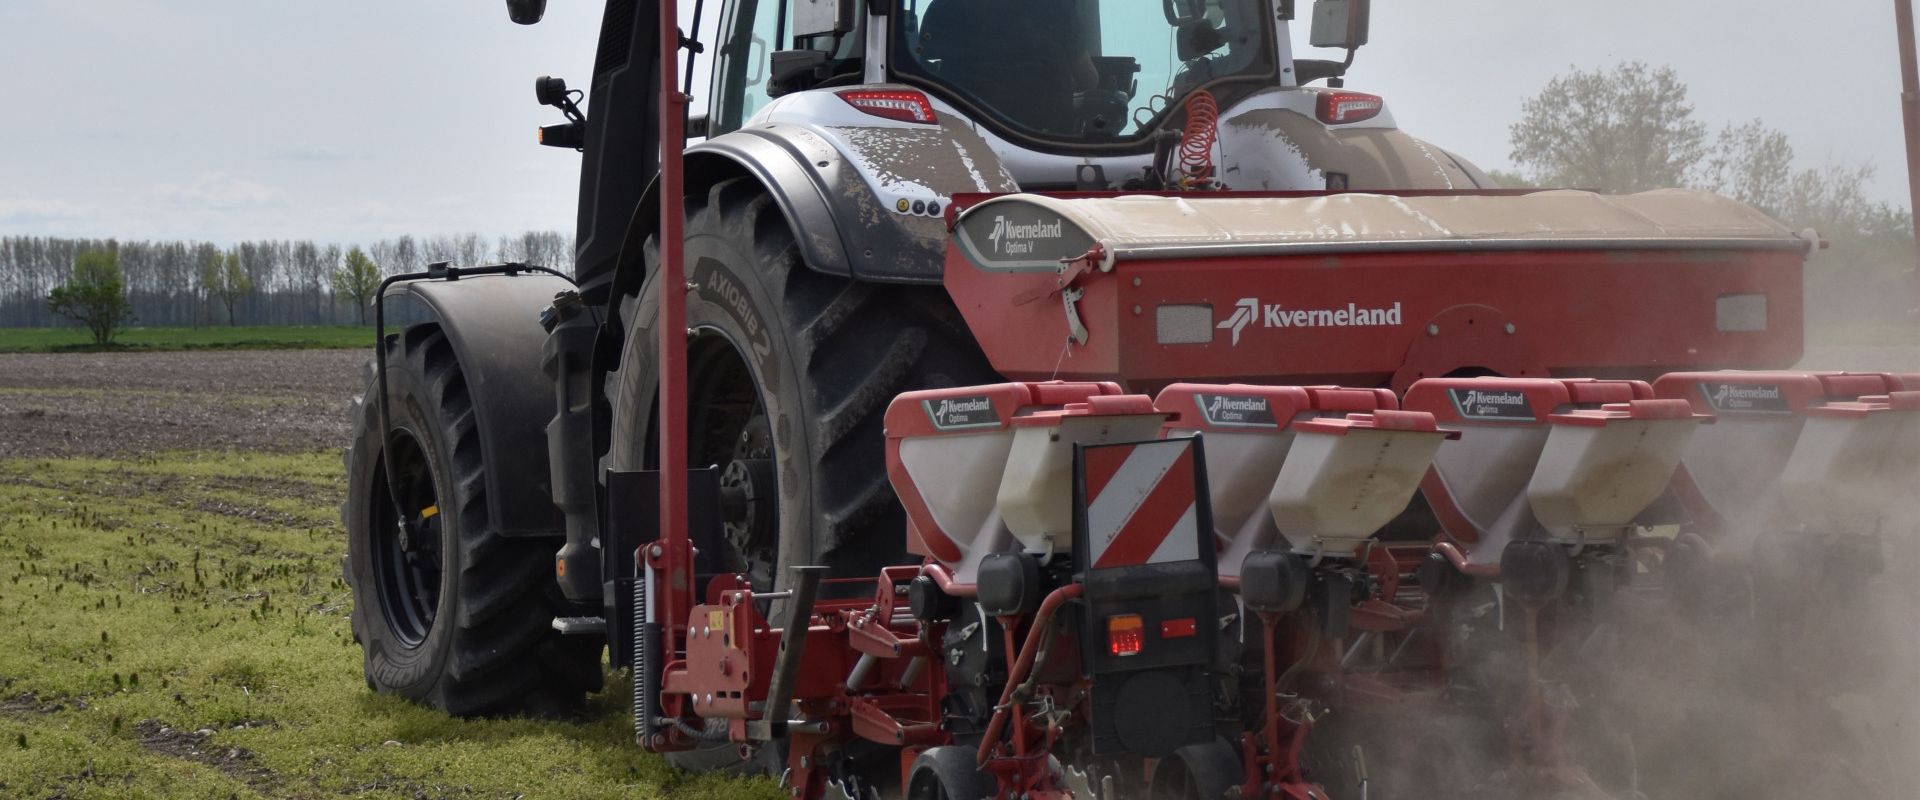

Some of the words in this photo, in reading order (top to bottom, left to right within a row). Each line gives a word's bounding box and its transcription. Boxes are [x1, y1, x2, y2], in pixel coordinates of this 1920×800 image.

[1006, 218, 1061, 239] Kverneland
[1005, 241, 1027, 255] Optima
[1028, 240, 1034, 253] V
[708, 270, 758, 335] AXIOBIB
[753, 328, 771, 365] 2
[1264, 302, 1401, 328] Kverneland
[1477, 391, 1524, 405] Kverneland
[1729, 385, 1778, 399] Kverneland
[948, 397, 990, 413] Kverneland
[1222, 397, 1266, 411] Kverneland
[1477, 405, 1498, 415] Optima
[949, 413, 969, 424] Optima
[1222, 410, 1242, 420] Optima
